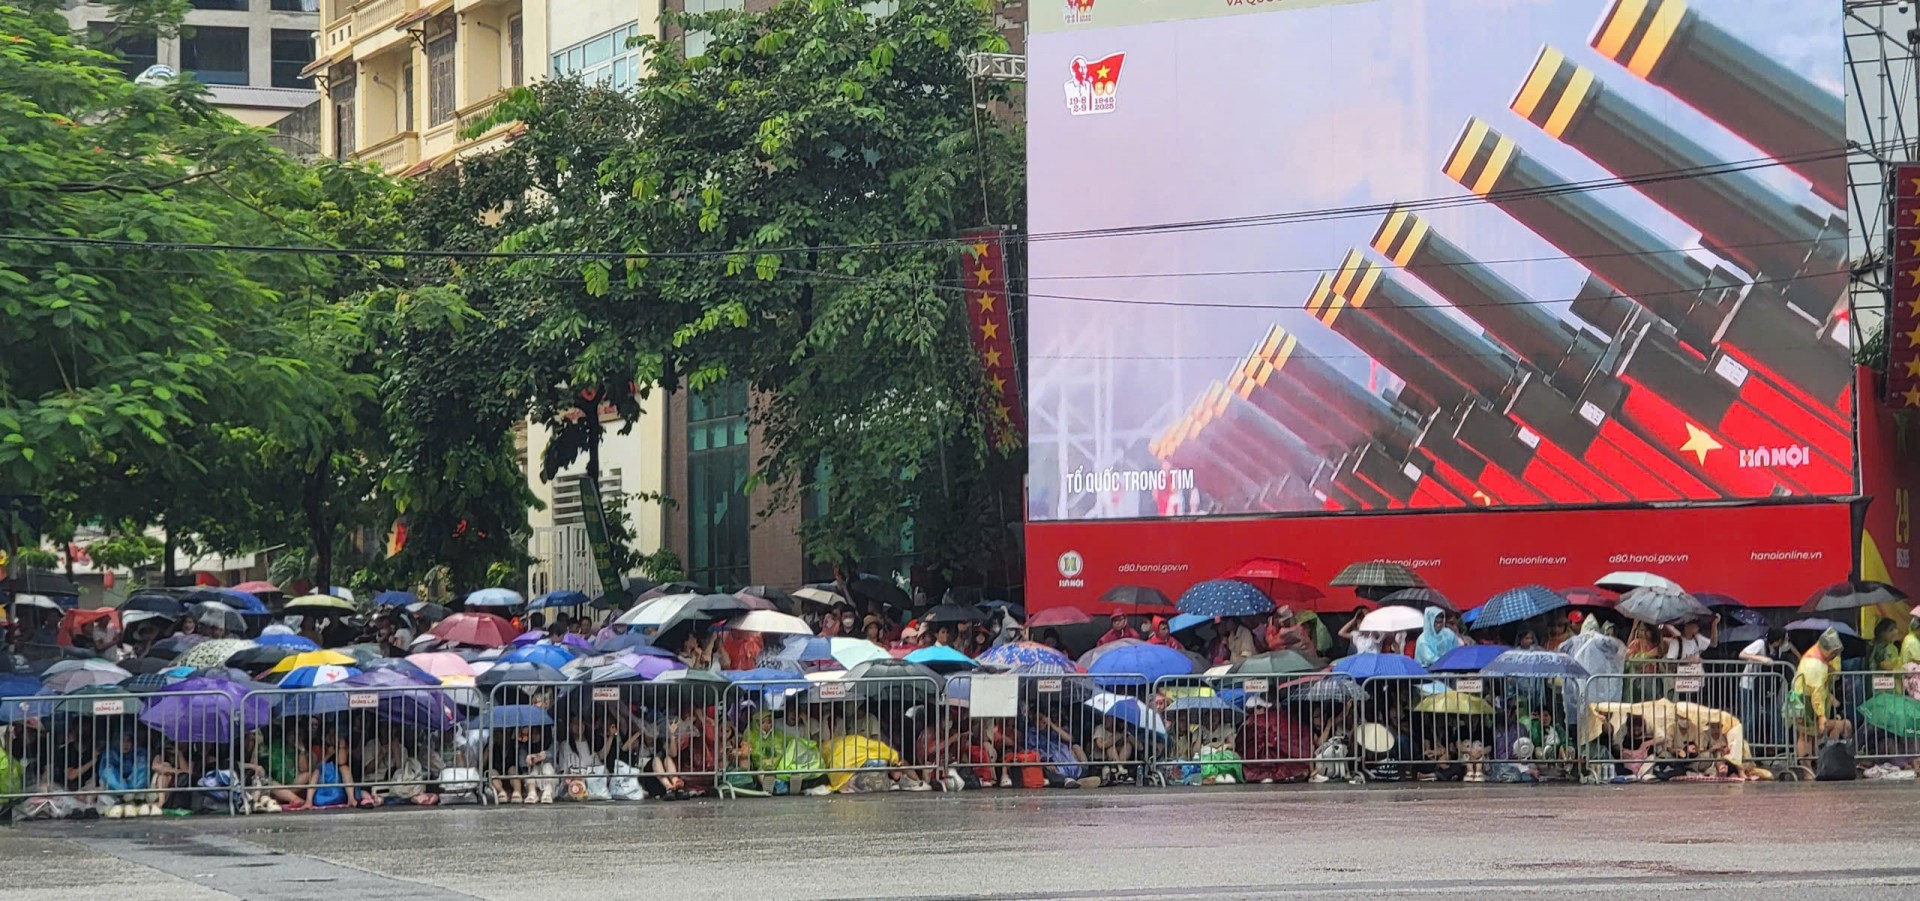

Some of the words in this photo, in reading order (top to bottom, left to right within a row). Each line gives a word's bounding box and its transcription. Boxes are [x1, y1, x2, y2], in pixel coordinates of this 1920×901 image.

[1095, 81, 1115, 96] 80
[1095, 103, 1115, 111] 2025
[1066, 465, 1084, 493] TỔ
[1085, 466, 1120, 493] QUỐC
[1123, 470, 1167, 492] TRONG
[1169, 469, 1194, 490] TIM
[1499, 555, 1568, 566] hanoionline.vn
[1608, 553, 1689, 565] a80.hanoi.gov.vn
[1750, 550, 1823, 561] hanoionline.vn
[1118, 563, 1189, 574] a80.hanoi.gov.vn
